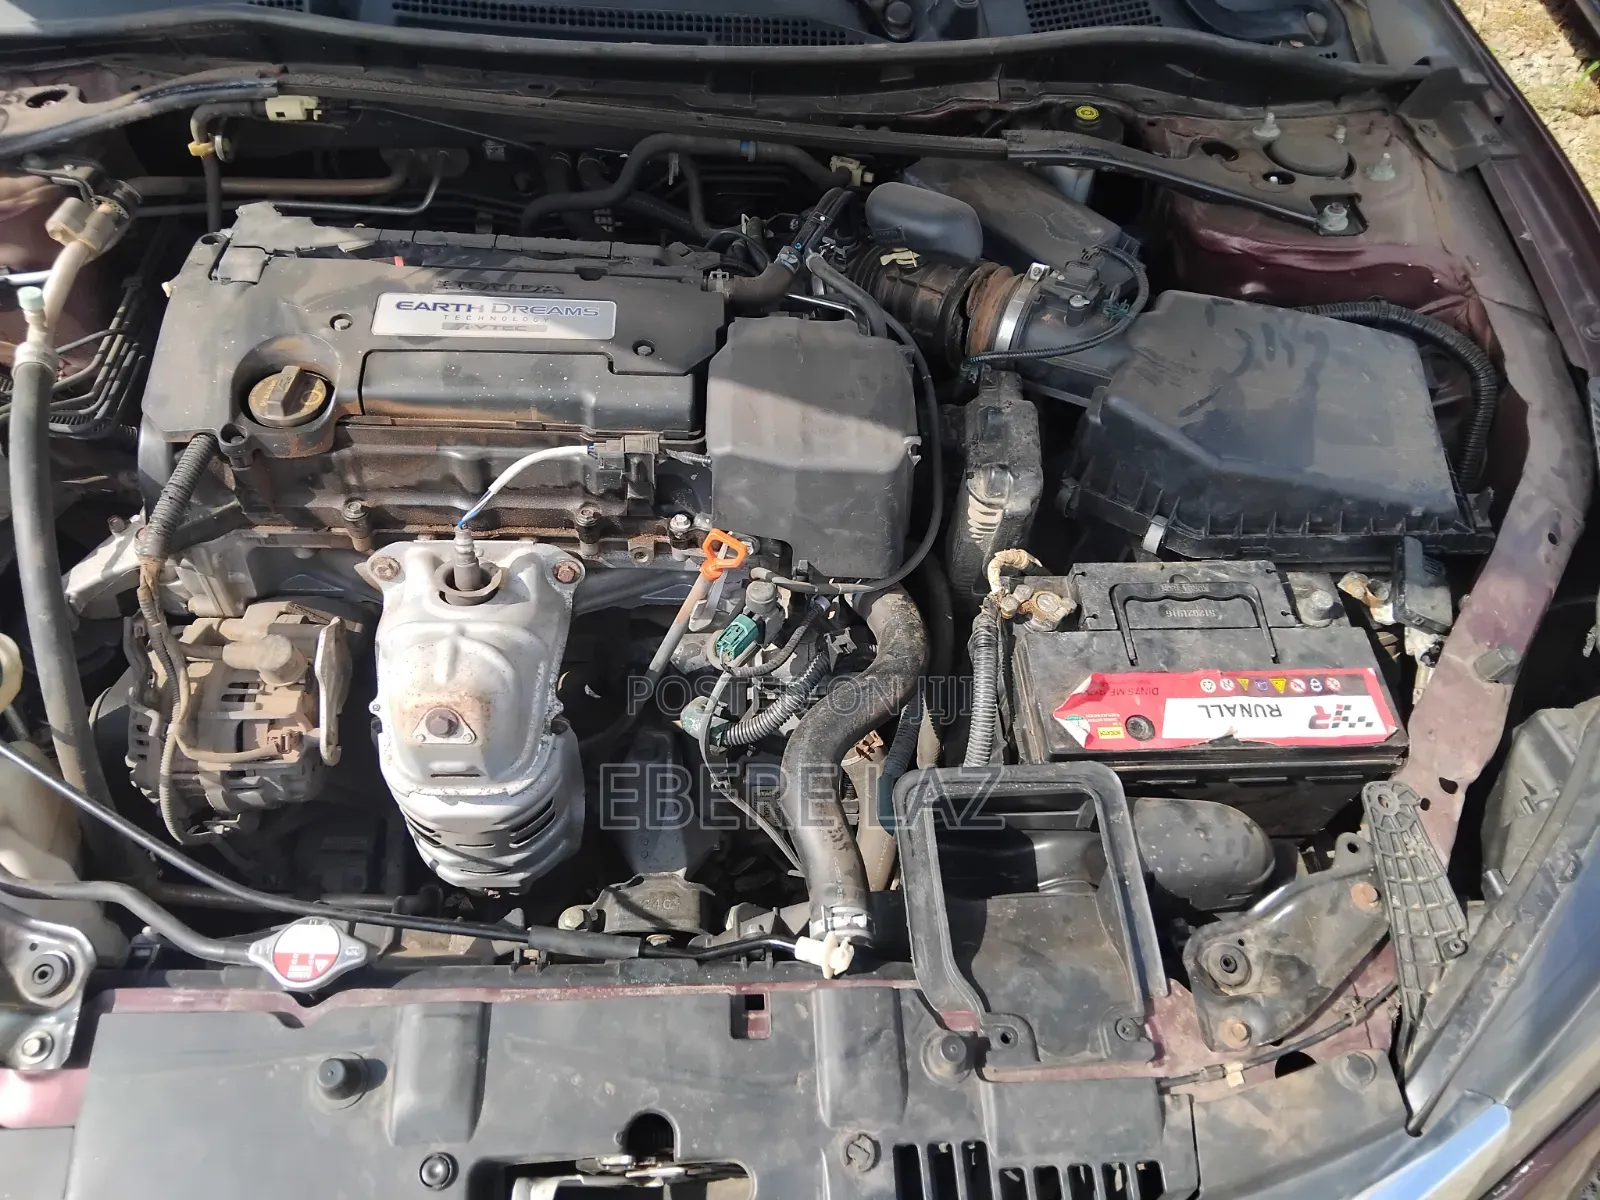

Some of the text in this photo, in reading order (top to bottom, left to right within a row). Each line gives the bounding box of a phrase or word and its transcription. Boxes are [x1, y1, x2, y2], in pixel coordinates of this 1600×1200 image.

[396, 301, 484, 313] EARTH
[444, 314, 550, 323] TECHNOLOGY
[1198, 703, 1283, 719] RUNALL
